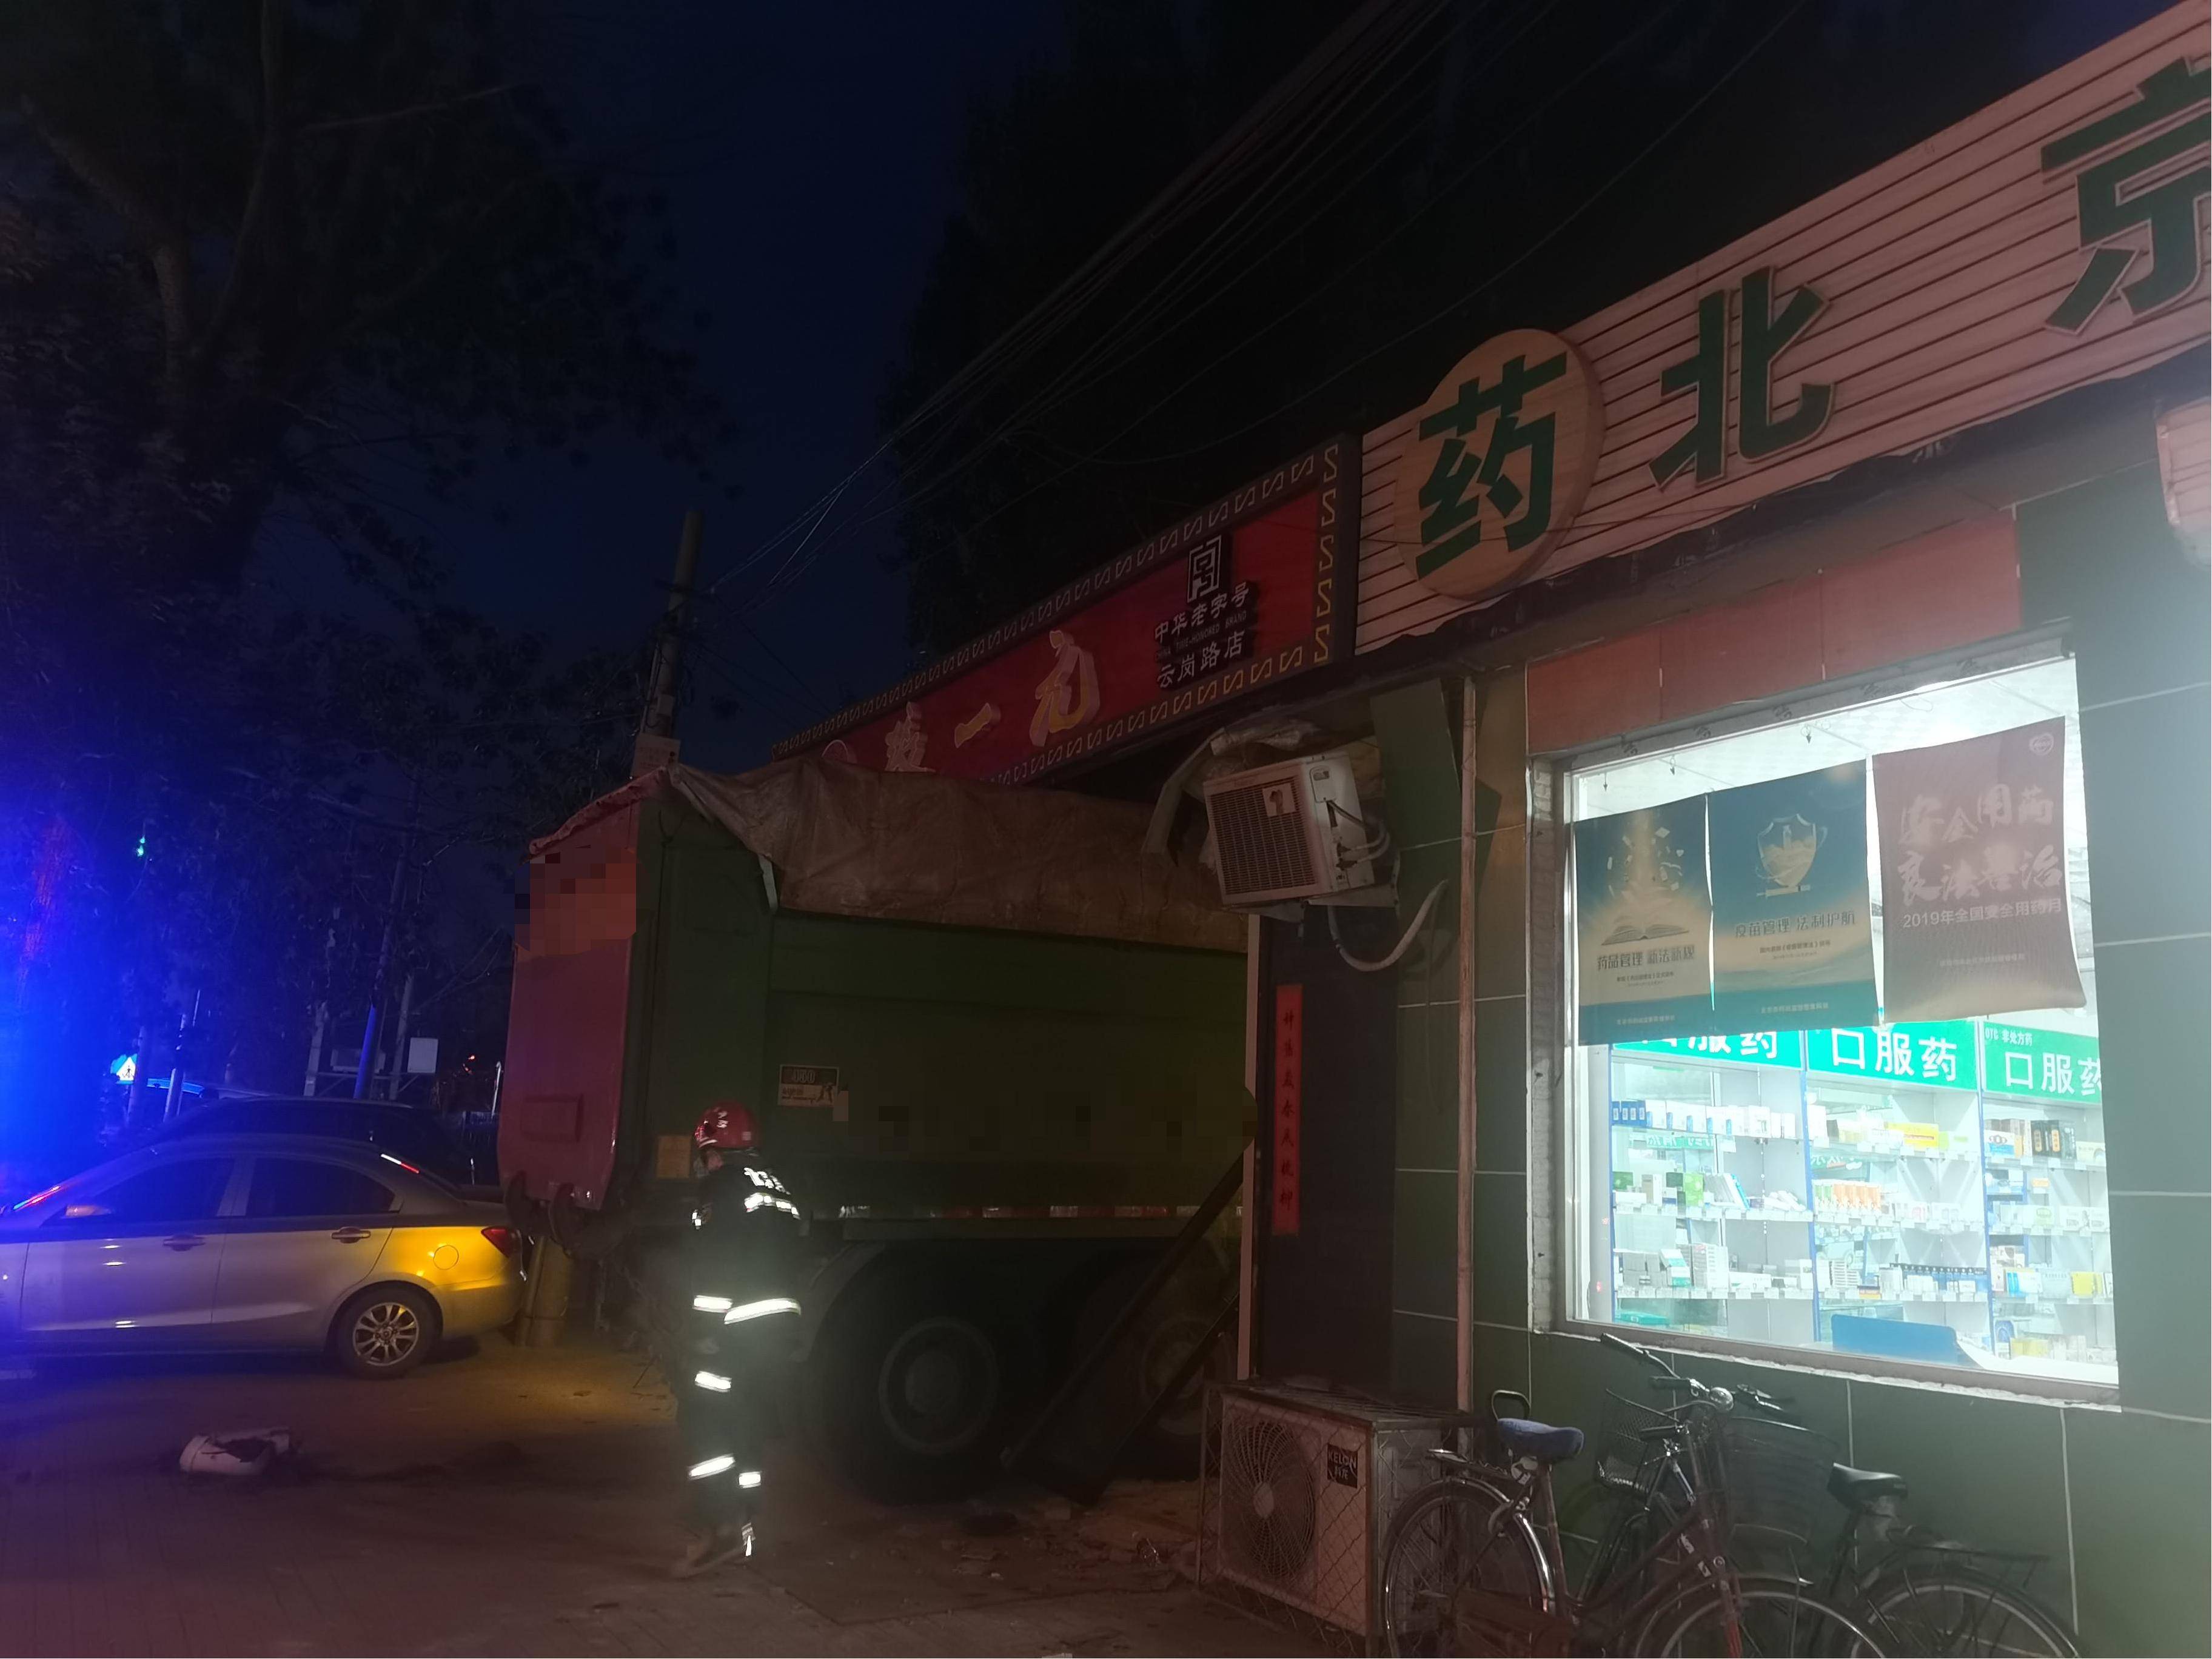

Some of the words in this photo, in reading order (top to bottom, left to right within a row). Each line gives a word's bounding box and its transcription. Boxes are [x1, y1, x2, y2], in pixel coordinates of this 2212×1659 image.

[1416, 353, 1567, 578] 药
[1154, 581, 1249, 643] 中华老字号
[1902, 898, 2062, 929] 2019年全国安全用药月
[1830, 1027, 1958, 1082] 口服药
